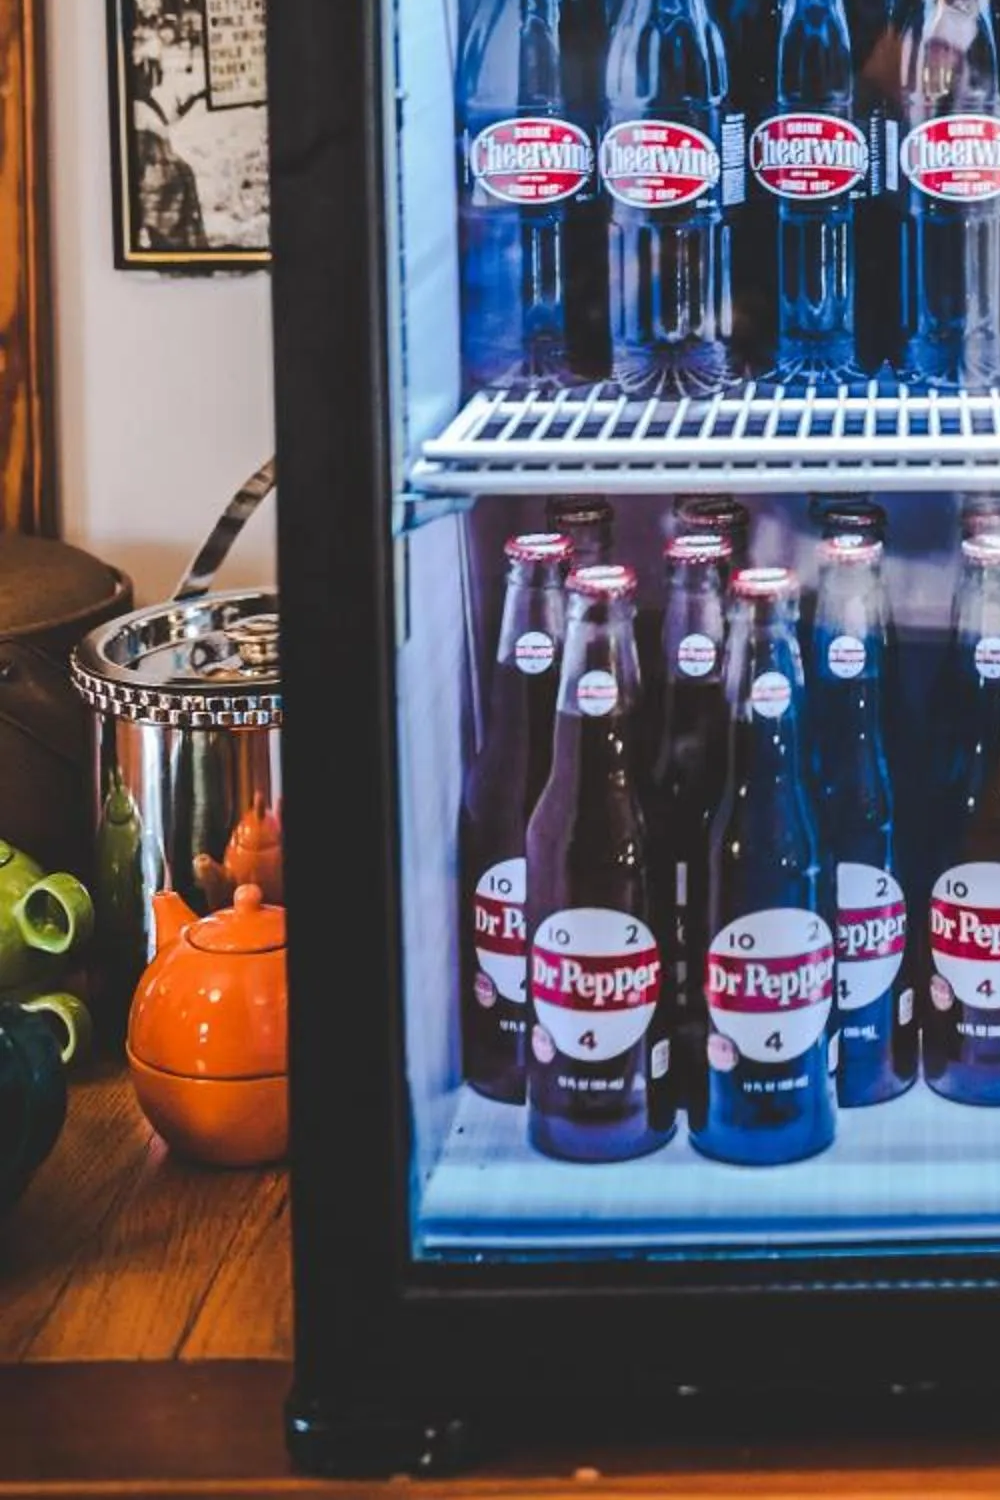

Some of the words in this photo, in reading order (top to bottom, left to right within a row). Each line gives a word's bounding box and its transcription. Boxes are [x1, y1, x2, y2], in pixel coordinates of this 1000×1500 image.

[489, 876, 512, 894] 10
[876, 878, 888, 898] 2
[945, 880, 968, 898] 10
[475, 905, 500, 932] Dr
[931, 910, 955, 937] Dr
[549, 928, 571, 946] 10
[625, 924, 640, 945] 2
[729, 933, 755, 950] 10
[807, 921, 820, 943] 2
[838, 912, 906, 956] epper
[533, 955, 558, 987] Dr
[559, 959, 661, 1006] Pepper
[708, 966, 741, 993] Dr
[745, 958, 833, 1005] Pepper
[976, 980, 994, 997] 4
[578, 1030, 598, 1051] 4
[764, 1030, 783, 1051] 4
